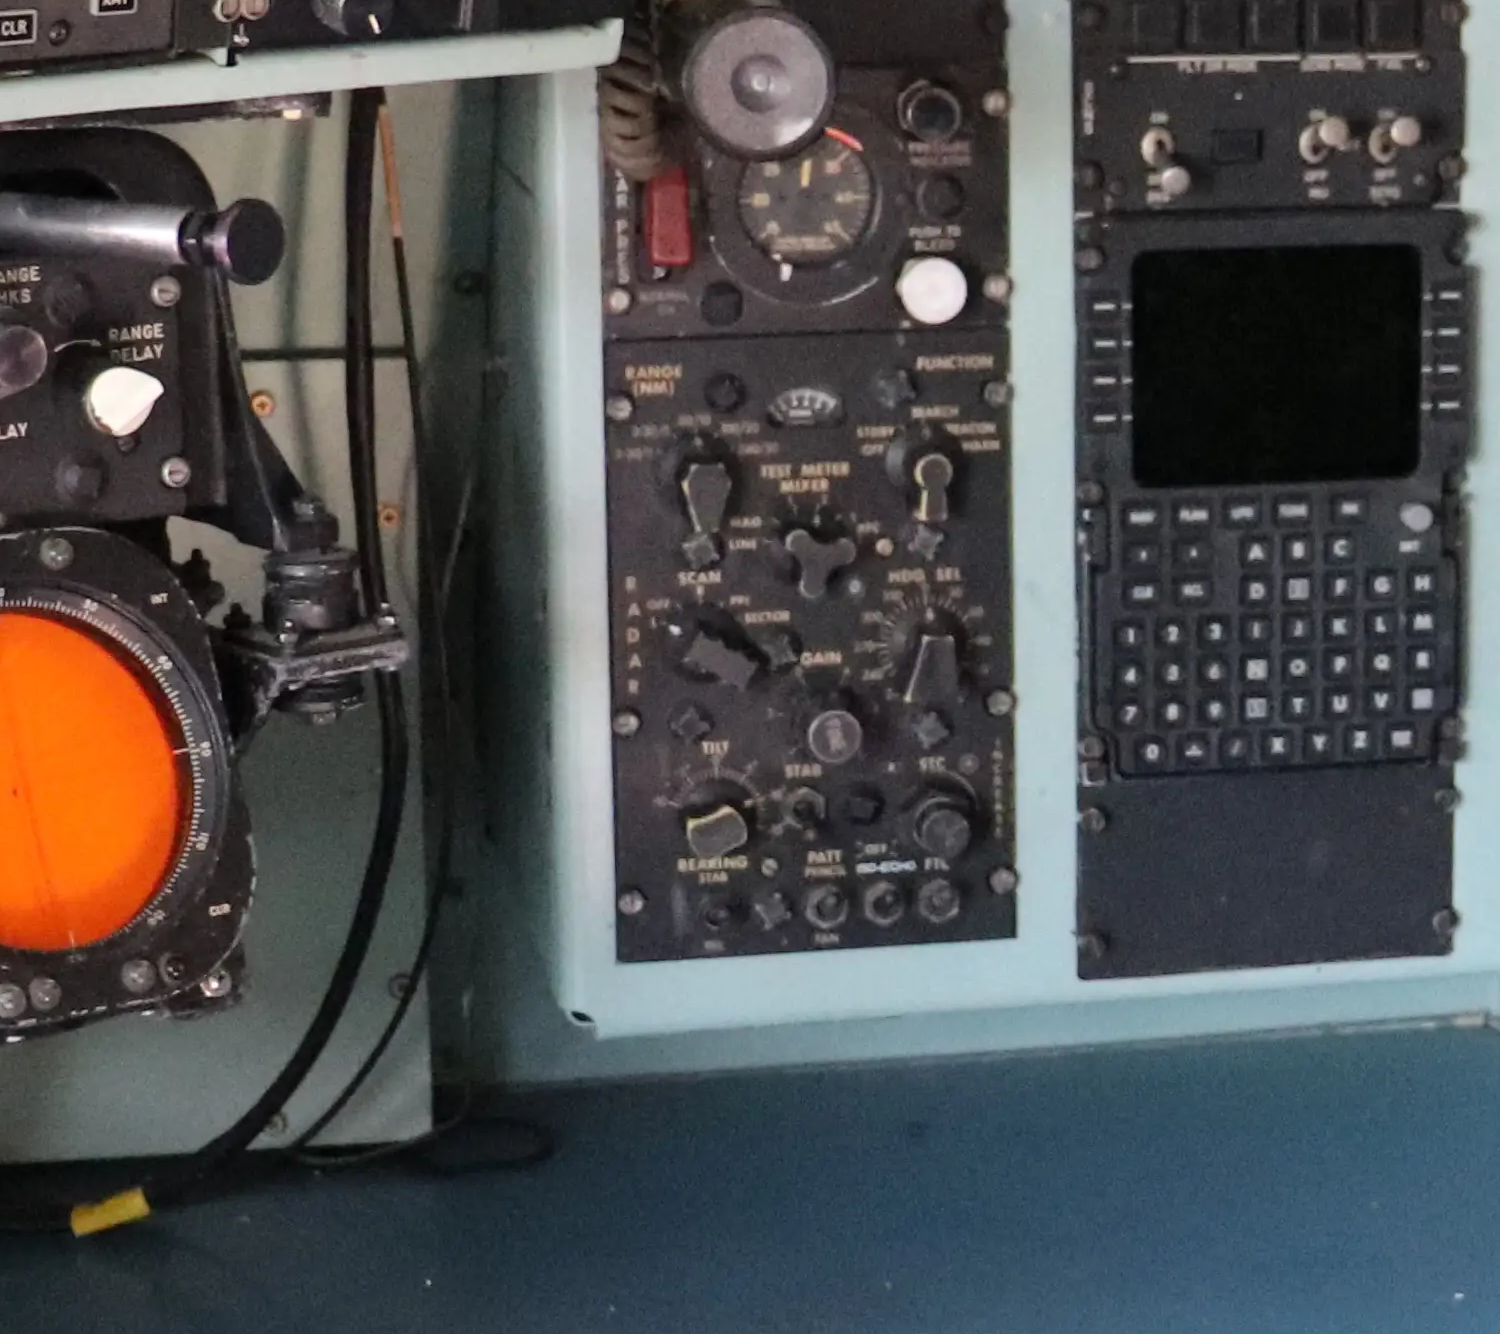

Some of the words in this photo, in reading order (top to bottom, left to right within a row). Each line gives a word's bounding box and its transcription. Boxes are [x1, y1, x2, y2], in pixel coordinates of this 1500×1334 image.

[1, 19, 27, 36] CLR
[108, 322, 165, 343] RANGE
[108, 344, 164, 363] DELAY
[916, 356, 994, 371] FUNCTION
[625, 365, 682, 380] RANGE
[800, 463, 852, 479] METER
[677, 571, 722, 586] SCAN
[800, 651, 842, 666] GAIN
